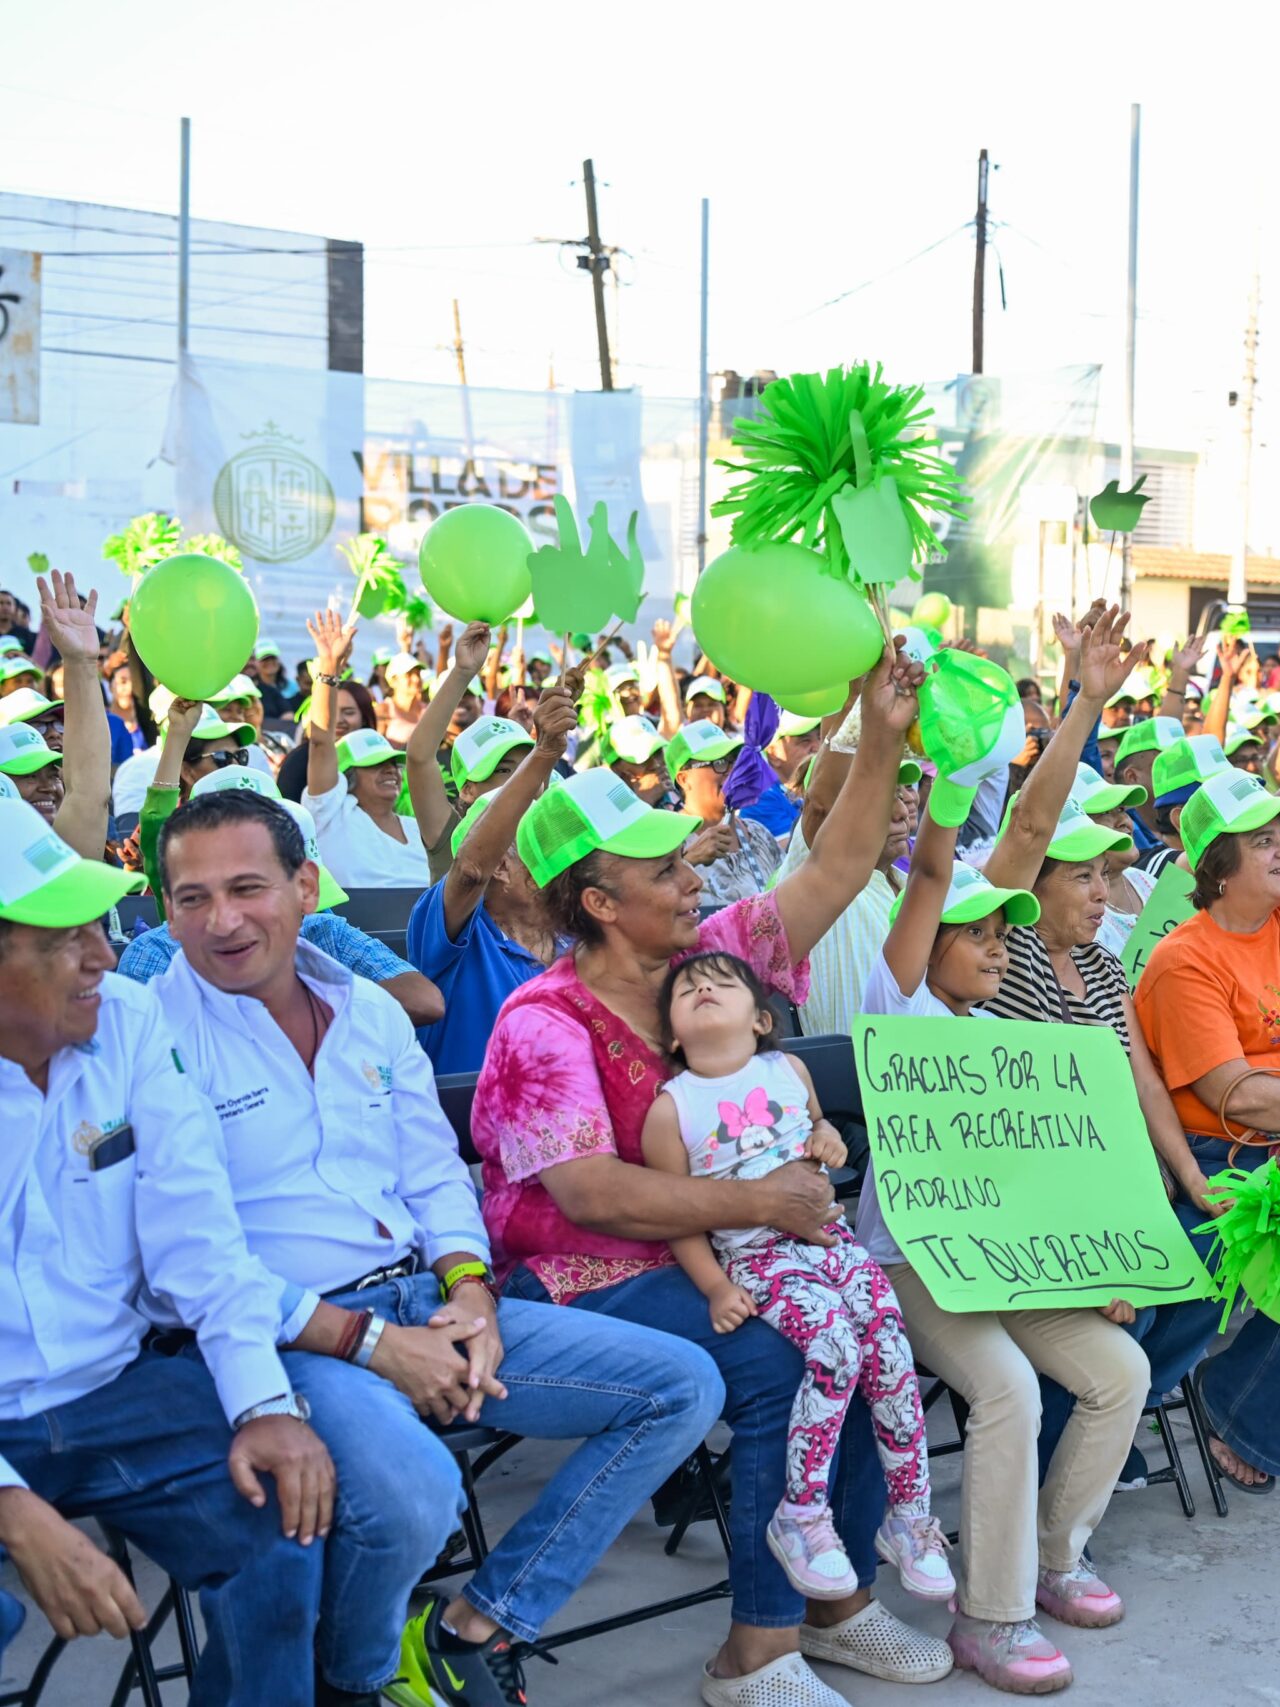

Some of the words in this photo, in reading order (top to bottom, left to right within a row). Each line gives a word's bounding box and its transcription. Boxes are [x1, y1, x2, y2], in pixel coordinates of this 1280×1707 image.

[864, 1027, 987, 1096] GRACIAS
[991, 1045, 1040, 1092] POR
[1053, 1052, 1087, 1096] LA
[876, 1114, 942, 1158] AREA
[950, 1107, 1107, 1152] RECREATIVA
[879, 1169, 1001, 1213] PADRINO
[906, 1233, 977, 1282] TE
[967, 1229, 1170, 1287] QUEREMOS
